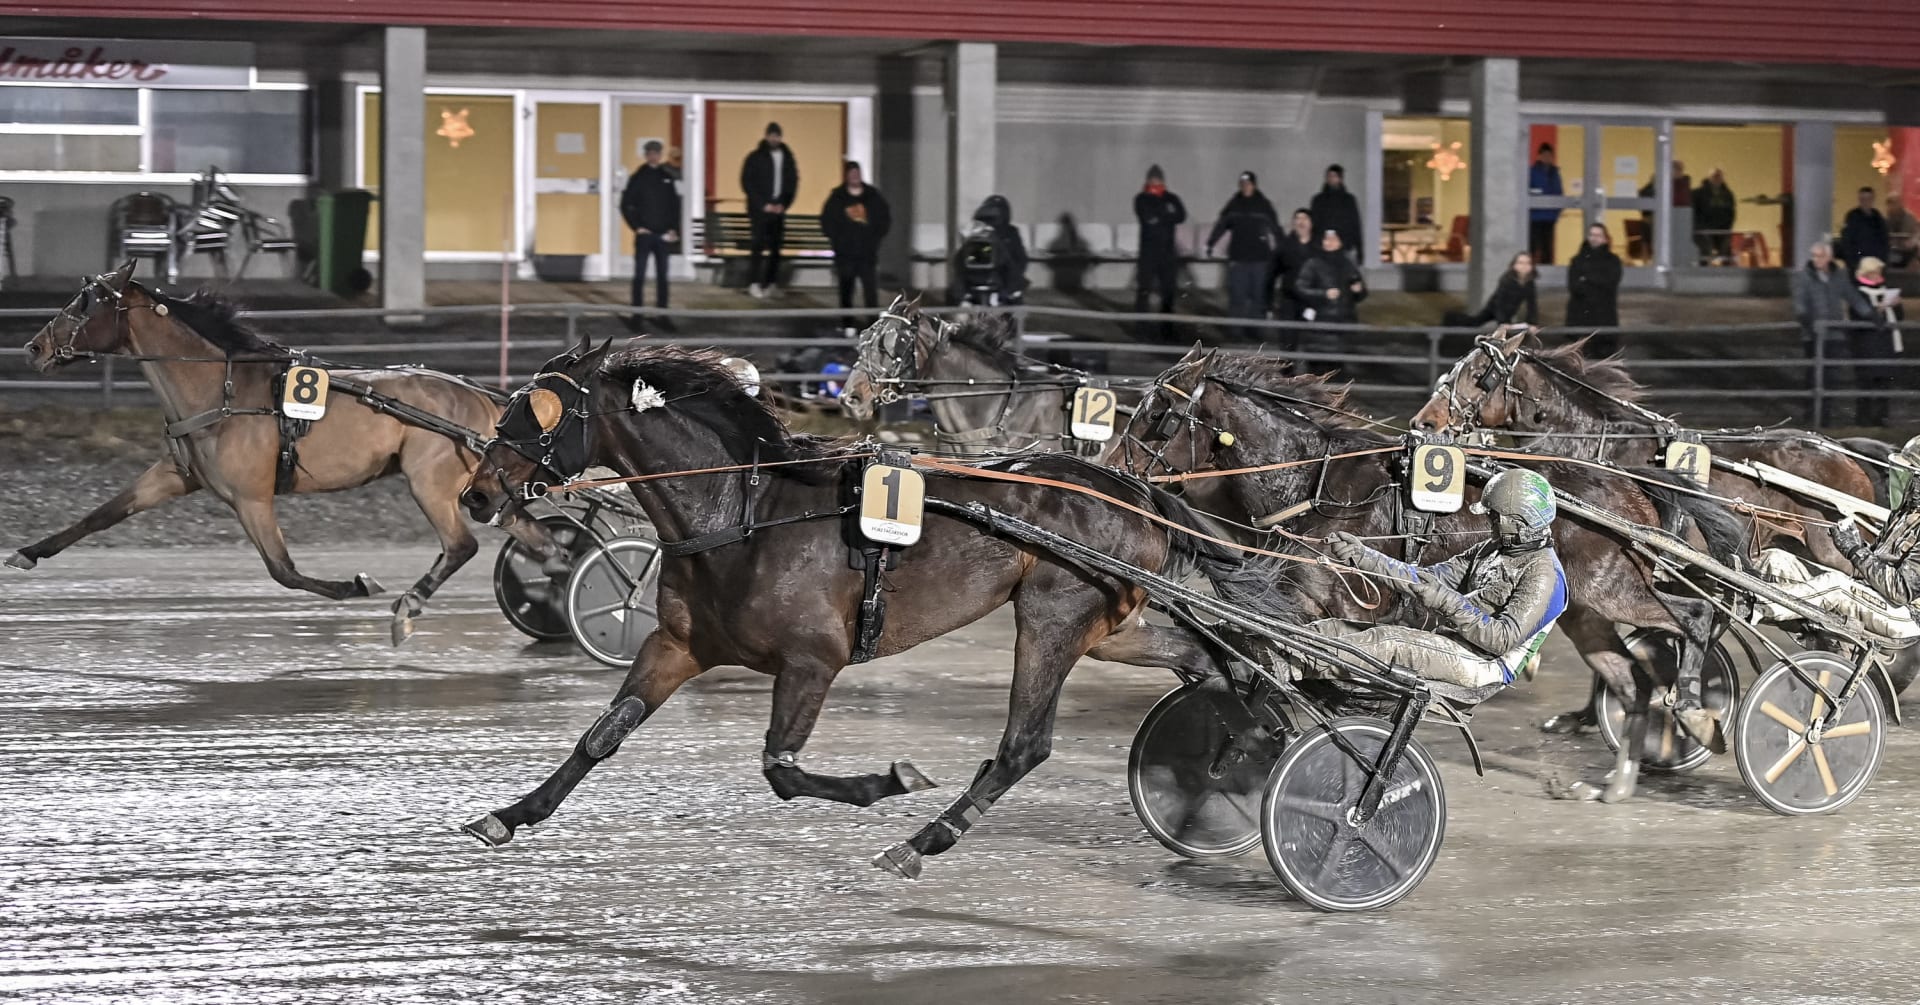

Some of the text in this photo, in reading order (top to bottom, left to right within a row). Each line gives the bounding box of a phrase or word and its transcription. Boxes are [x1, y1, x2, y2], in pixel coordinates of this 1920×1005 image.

[293, 369, 319, 404] 8
[1079, 390, 1113, 427] 12
[1424, 447, 1454, 492] 9
[1673, 446, 1699, 480] 4
[882, 469, 901, 520] 1
